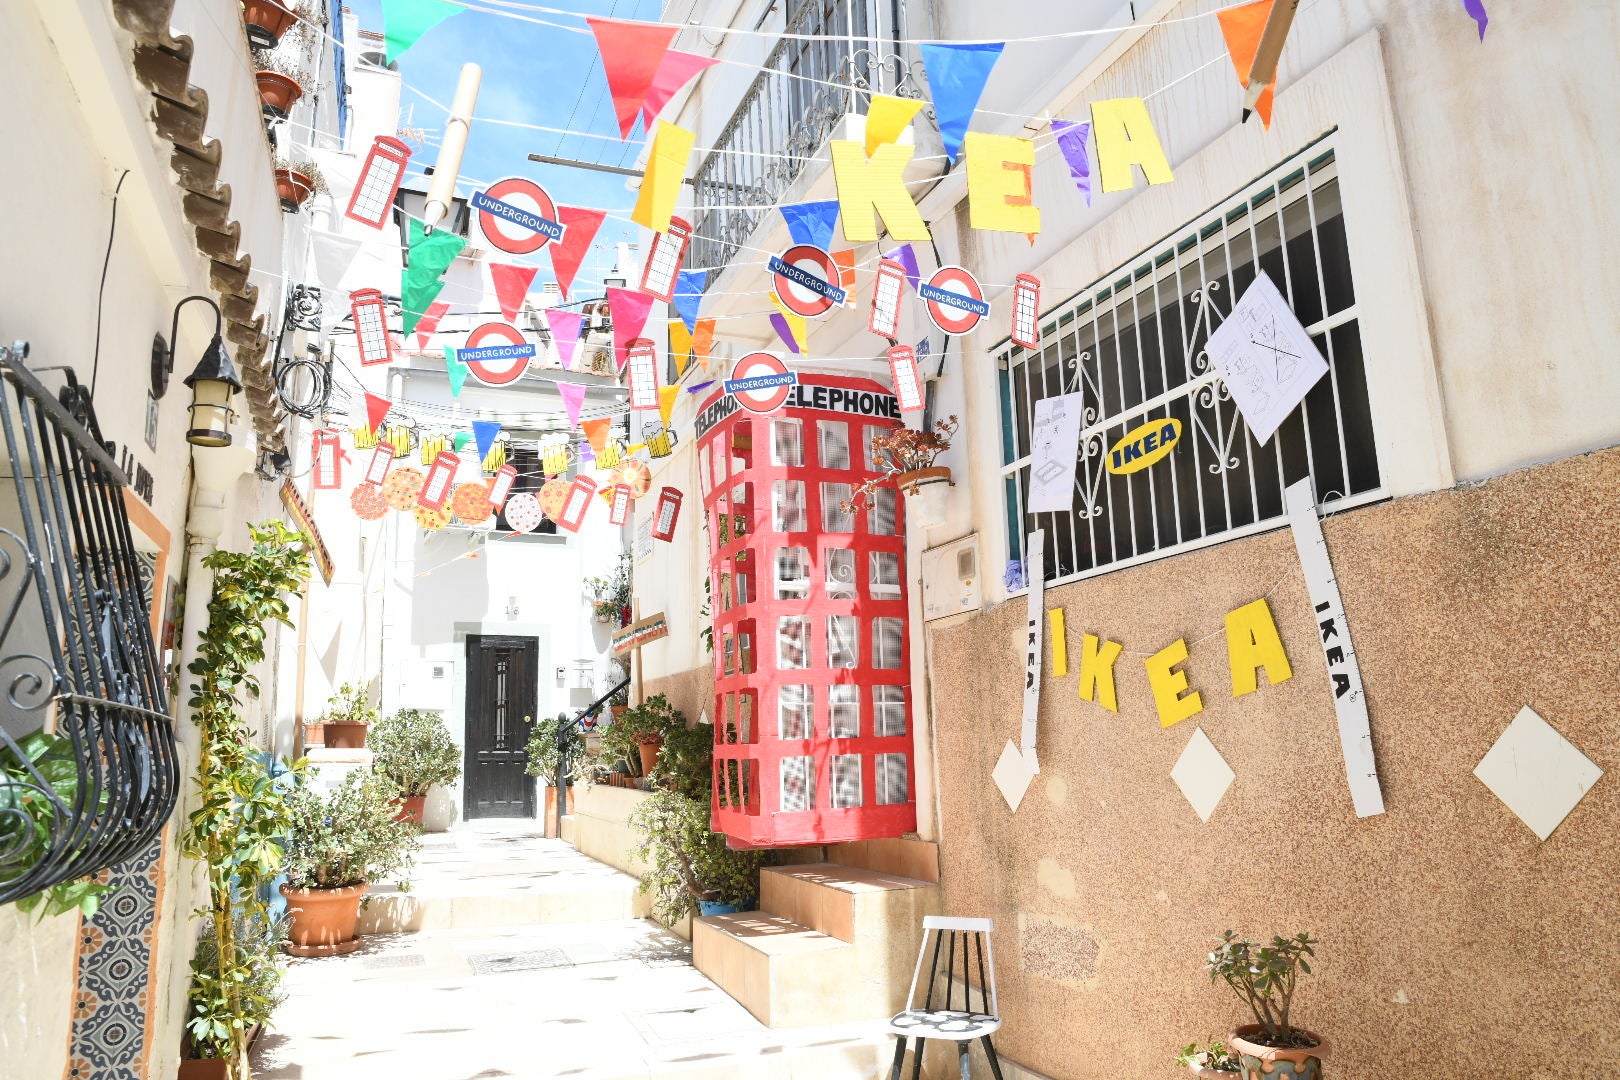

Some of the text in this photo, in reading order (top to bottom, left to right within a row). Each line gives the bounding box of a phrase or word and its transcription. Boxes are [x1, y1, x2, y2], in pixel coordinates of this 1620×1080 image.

[478, 196, 560, 238] UNDERGROUND
[774, 261, 843, 301] UNDERGROUND
[923, 288, 985, 314] UNDERGROUND
[460, 346, 532, 361] UNDERGROUND
[729, 375, 794, 391] UNDERGROUND
[1112, 422, 1177, 470] IKEA
[1027, 619, 1036, 690] IKEA
[1048, 597, 1293, 728] IKEA
[1315, 601, 1351, 699] IKEA
